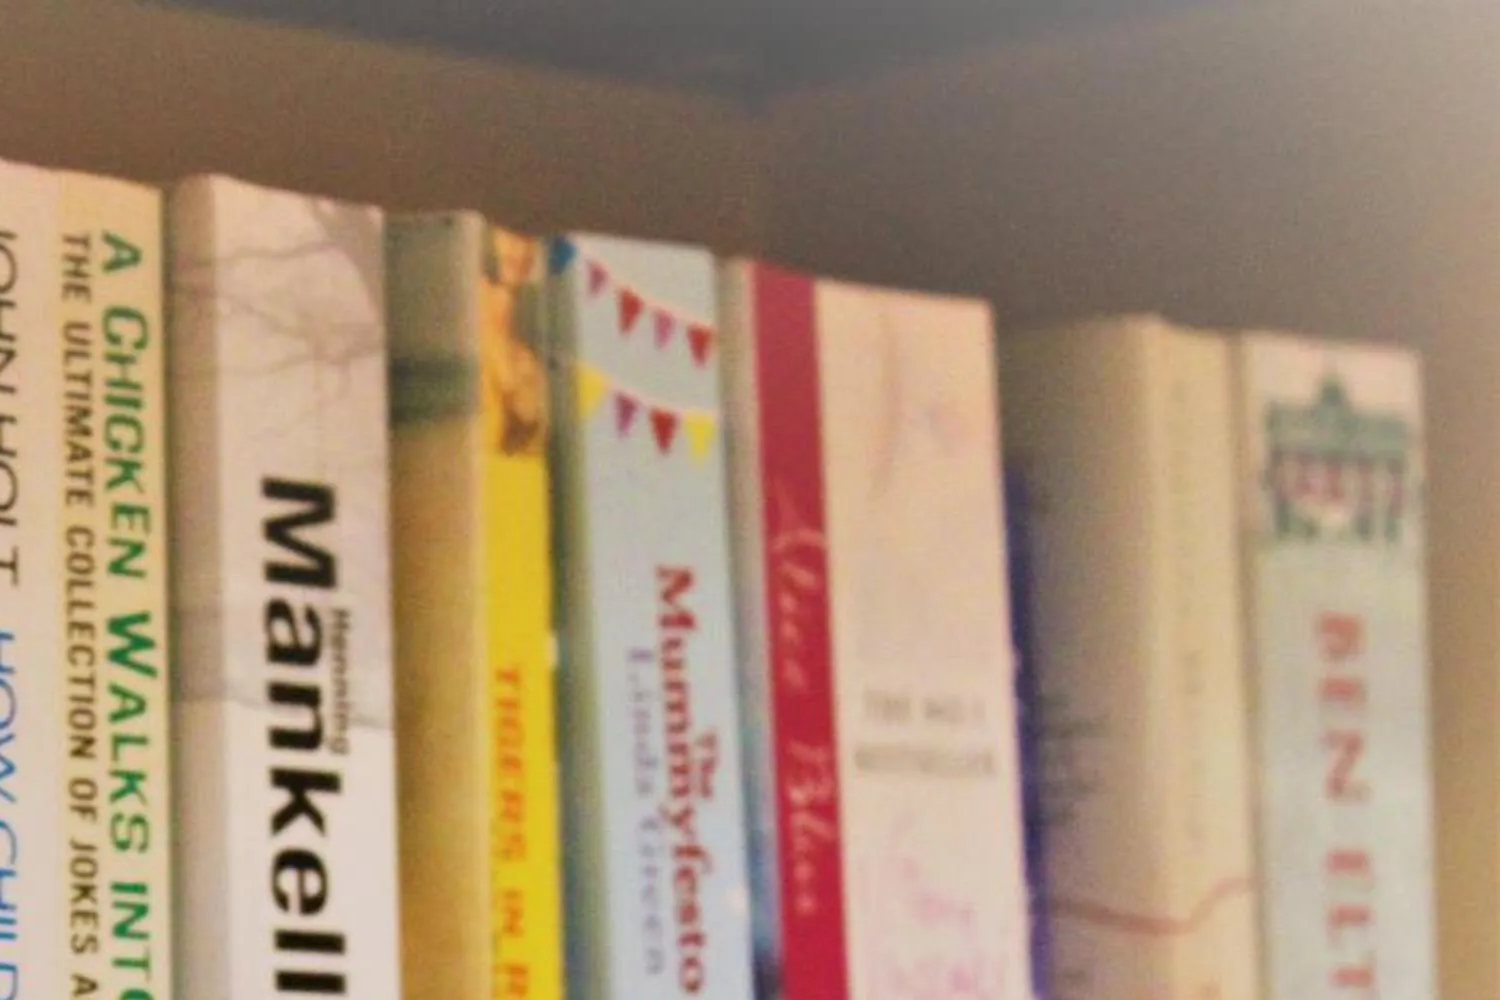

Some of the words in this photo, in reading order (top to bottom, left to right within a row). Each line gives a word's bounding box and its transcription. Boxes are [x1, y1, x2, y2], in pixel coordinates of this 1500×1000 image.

[61, 232, 92, 302] THE
[101, 231, 143, 275] A
[63, 319, 95, 510] ULTIMATE
[101, 305, 149, 580] CHICKEN
[65, 523, 99, 759] COLLECTION
[104, 609, 158, 854] WALKS
[259, 474, 348, 996] Mankell
[330, 607, 355, 757] Henning
[68, 775, 99, 824] OF
[494, 663, 528, 861] TIGERS
[656, 564, 713, 997] Mummyfesto
[69, 837, 100, 957] JOKES
[502, 889, 526, 939] IN
